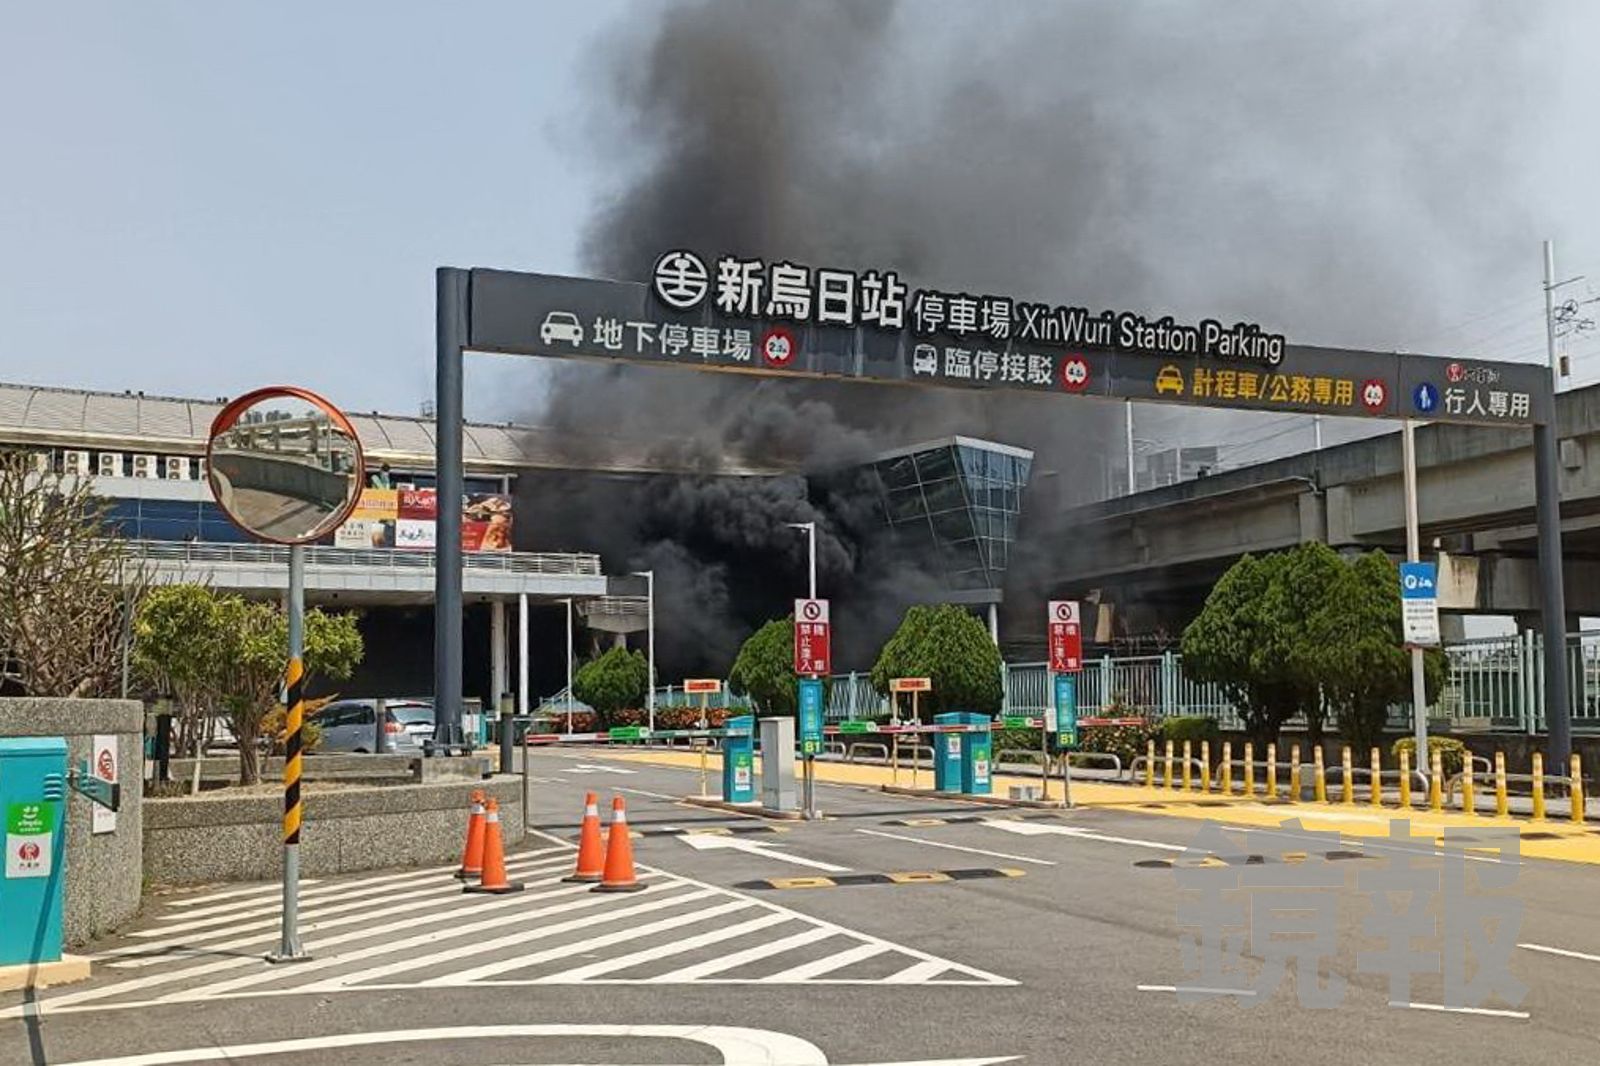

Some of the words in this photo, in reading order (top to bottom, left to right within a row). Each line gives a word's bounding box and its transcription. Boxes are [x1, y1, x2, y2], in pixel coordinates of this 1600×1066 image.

[716, 257, 906, 329] 新烏日站
[914, 293, 1011, 340] 停車場
[592, 316, 753, 362] 地下停車場
[1020, 306, 1112, 346] XinWuri
[1119, 315, 1197, 354] Station
[1204, 323, 1282, 365] Parking
[943, 347, 1054, 386] 臨停接駁
[1192, 368, 1355, 408] 計程車/公務專用
[1444, 387, 1530, 419] 行人專用
